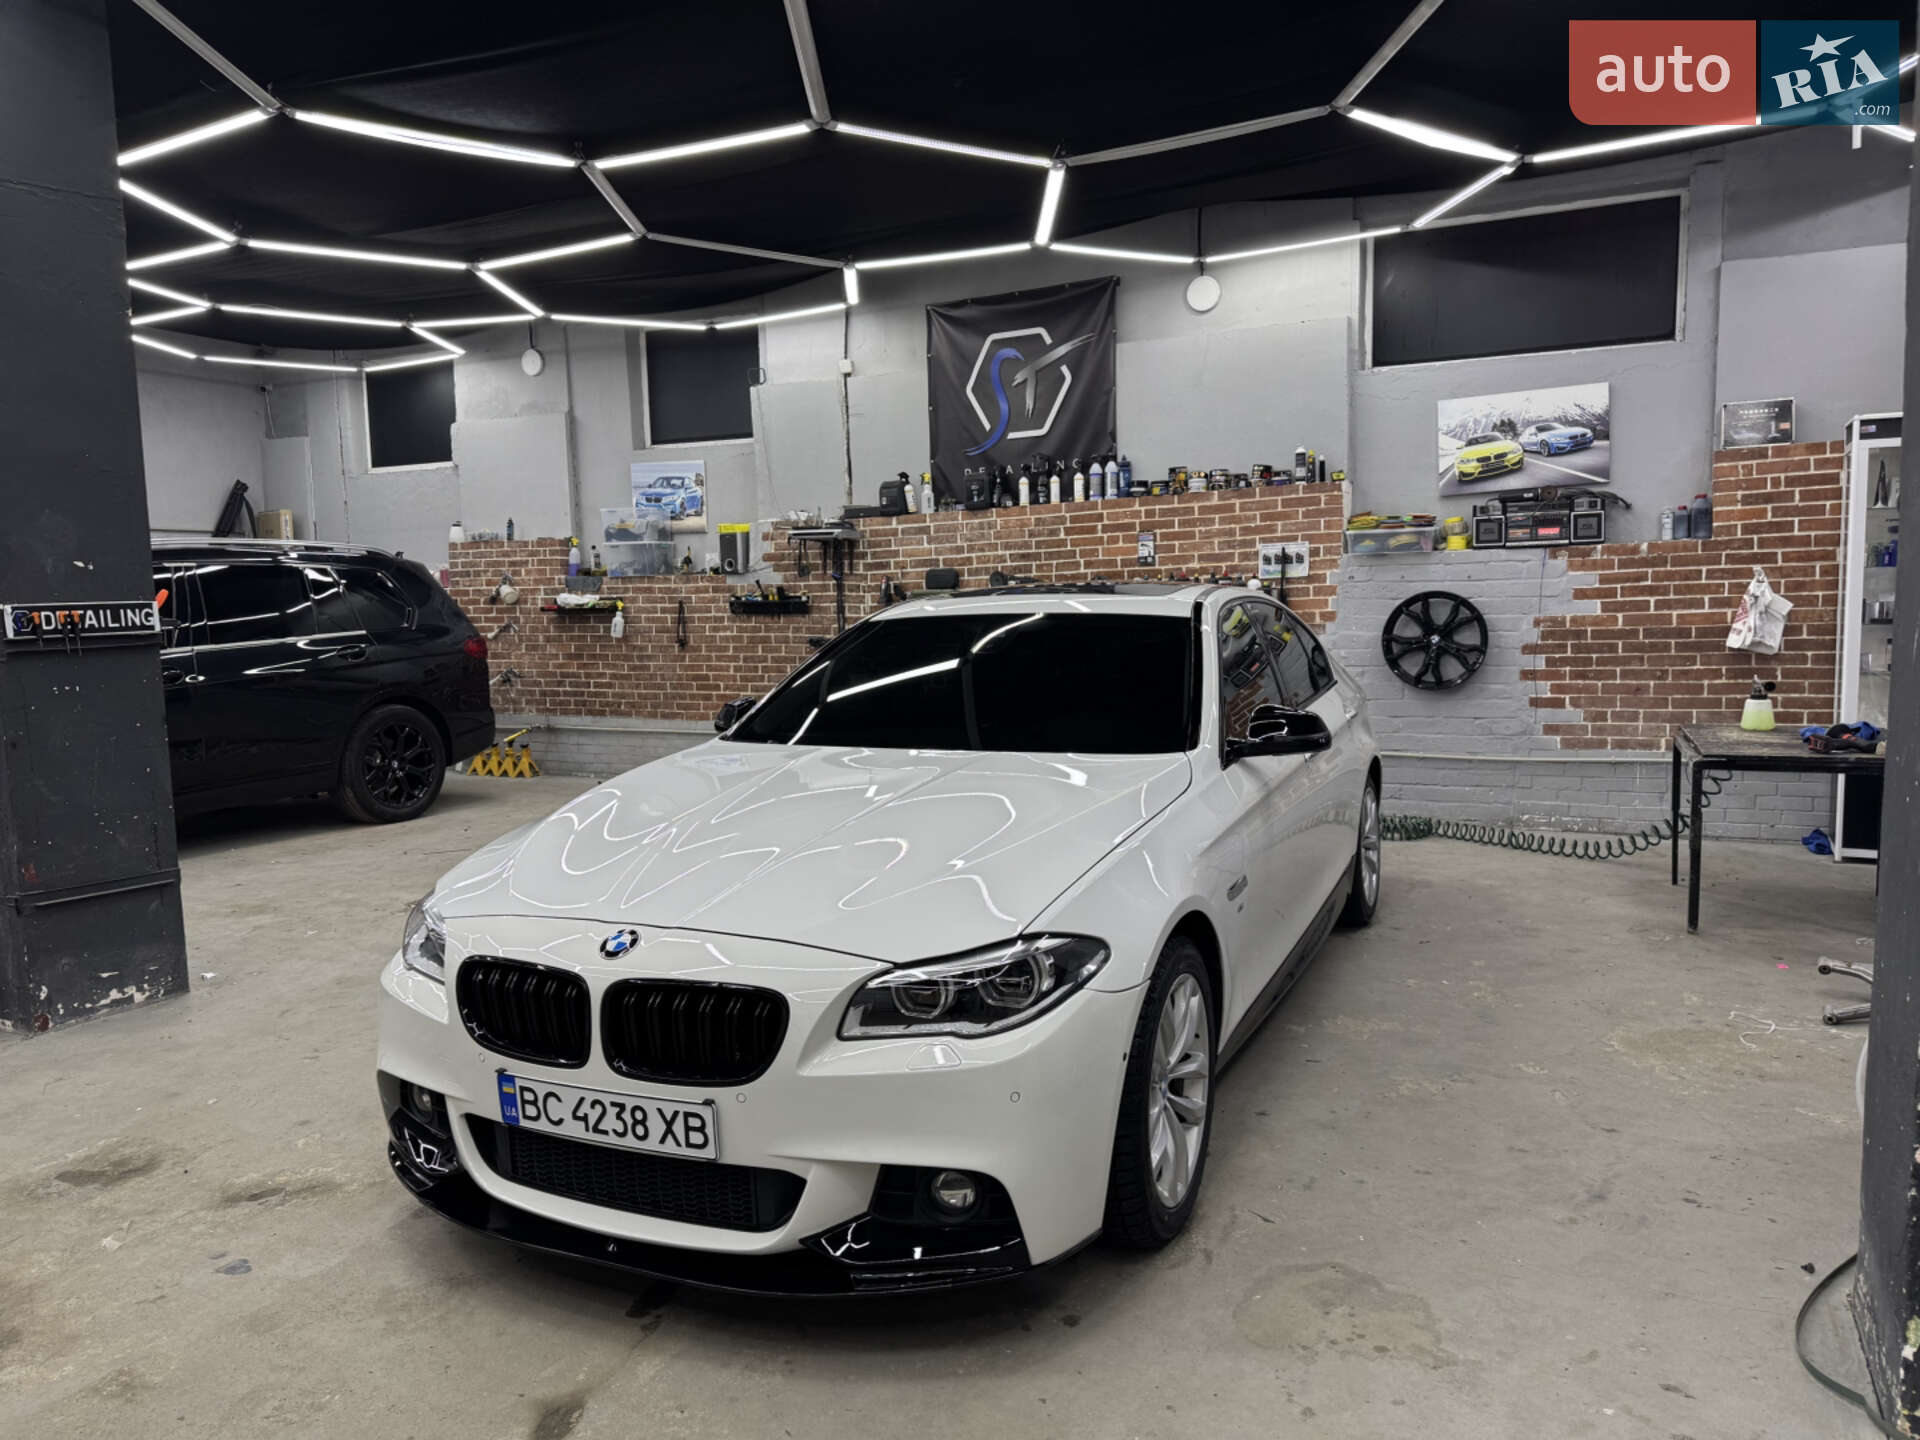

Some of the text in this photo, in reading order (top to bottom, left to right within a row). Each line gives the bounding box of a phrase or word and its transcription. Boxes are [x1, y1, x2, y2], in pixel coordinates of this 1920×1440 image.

[964, 457, 1082, 476] DEALING
[518, 1085, 709, 1149] BC 4238 XB
